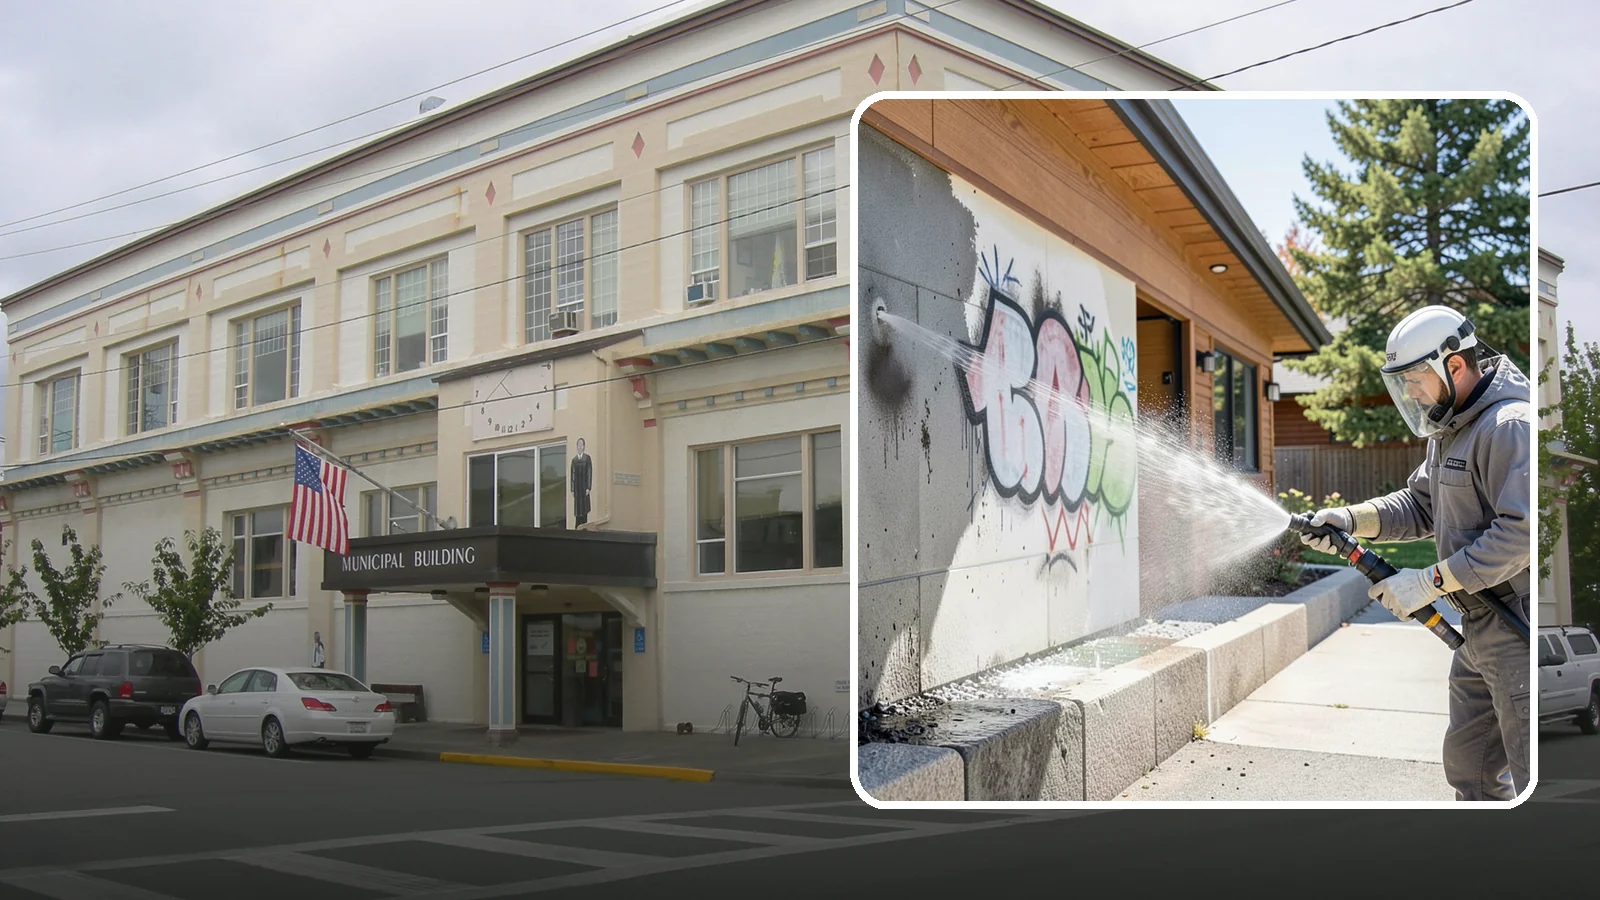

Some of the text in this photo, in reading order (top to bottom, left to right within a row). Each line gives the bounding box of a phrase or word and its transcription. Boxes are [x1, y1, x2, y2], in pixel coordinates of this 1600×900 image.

[481, 407, 485, 415] 8
[488, 417, 492, 425] 9
[502, 425, 506, 433] 11
[508, 425, 513, 433] 12
[521, 420, 525, 428] 2
[529, 414, 533, 422] 3
[536, 402, 540, 410] 4
[342, 546, 475, 572] MUNICIPAL BUILDING
